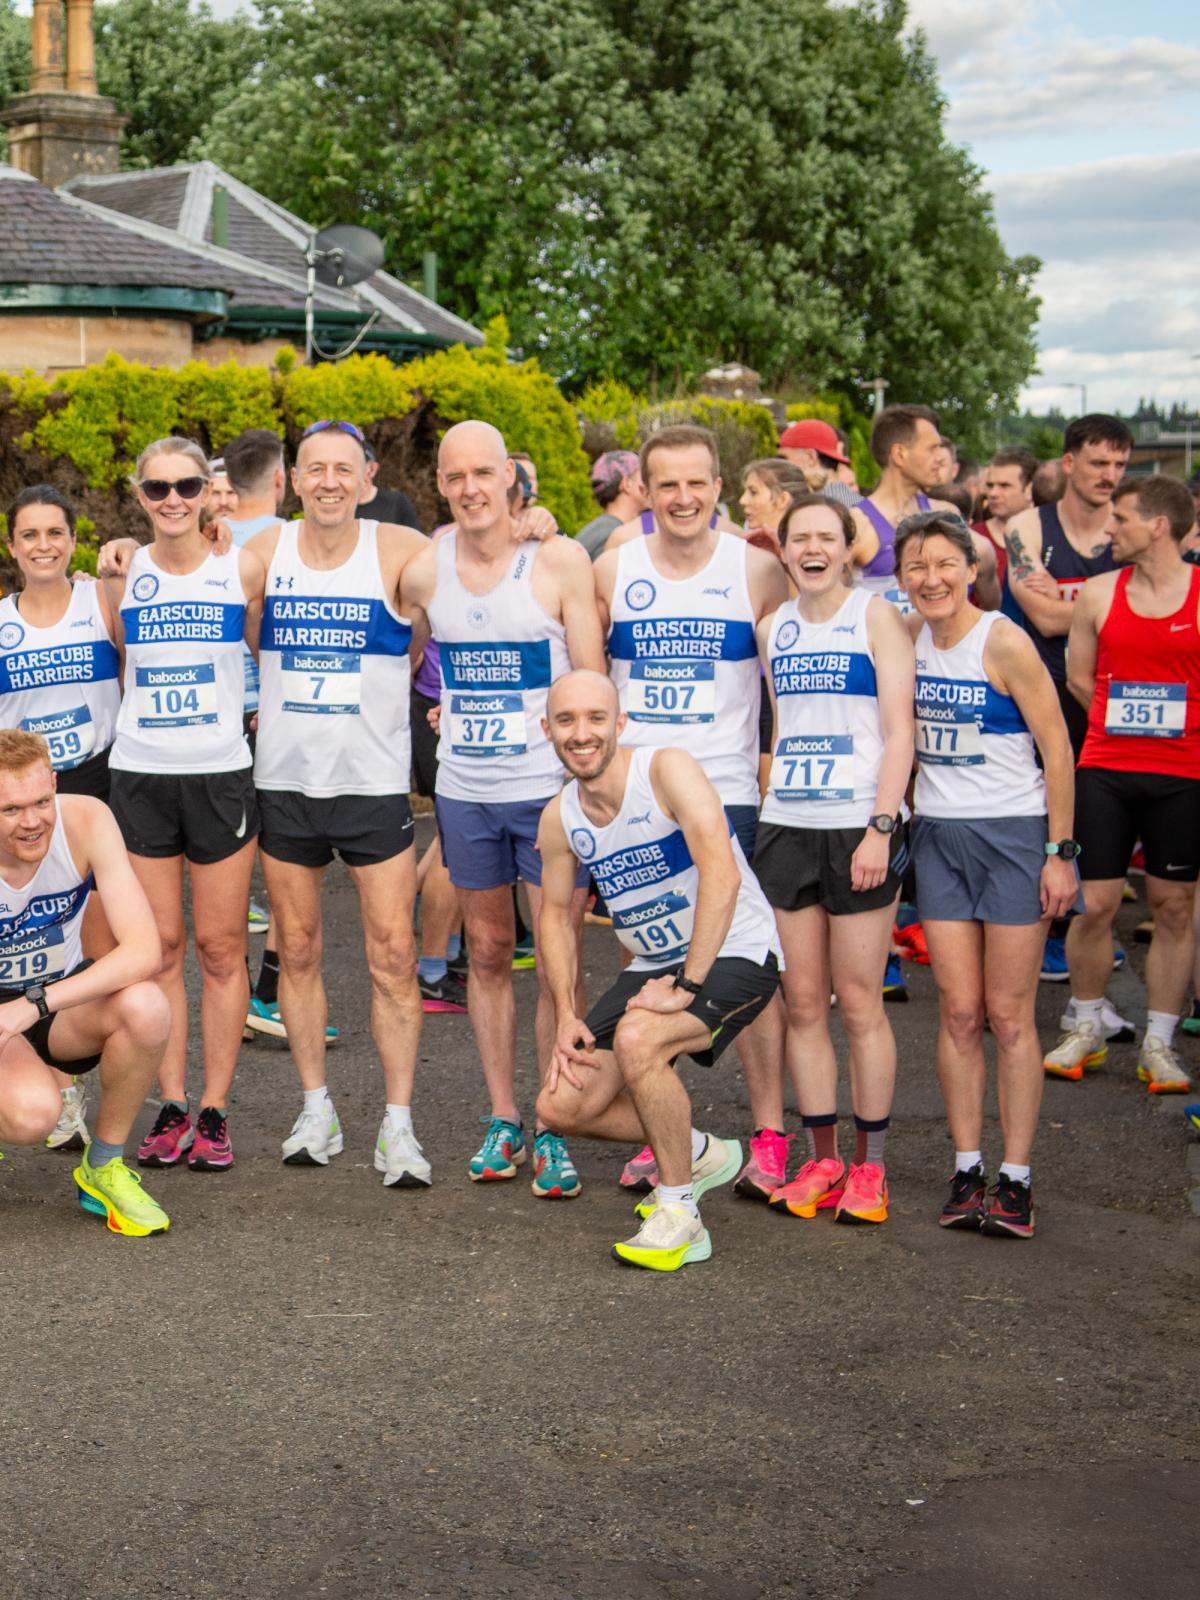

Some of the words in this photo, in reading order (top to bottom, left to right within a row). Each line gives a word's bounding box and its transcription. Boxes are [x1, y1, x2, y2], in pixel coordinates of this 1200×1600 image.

[514, 552, 527, 580] soar
[138, 605, 224, 624] GARSCUBE
[273, 601, 371, 623] GARSCUBE
[137, 623, 223, 641] HARRIERS
[273, 628, 367, 648] HARRIERS
[632, 621, 726, 640] GARSCUBE
[635, 639, 723, 658] HARRIERS
[6, 645, 94, 673] GARSCUBE
[294, 657, 343, 670] babcock
[774, 655, 851, 674] GARSCUBE
[9, 663, 93, 690] HARRIERS
[147, 669, 197, 684] babcock
[644, 664, 696, 679] babcock
[309, 676, 326, 700] 7
[644, 685, 696, 710] 507
[1122, 686, 1169, 698] babcock
[150, 688, 199, 714] 104
[460, 698, 505, 712] babcock
[28, 713, 76, 733] babcock
[917, 706, 956, 721] babcock
[1121, 703, 1164, 724] 351
[462, 718, 507, 742] 372
[921, 724, 958, 752] 177
[786, 738, 833, 752] babcock
[783, 757, 835, 787] 717
[596, 860, 671, 897] HARRIERS
[619, 900, 670, 926] babcock
[632, 918, 684, 952] 191
